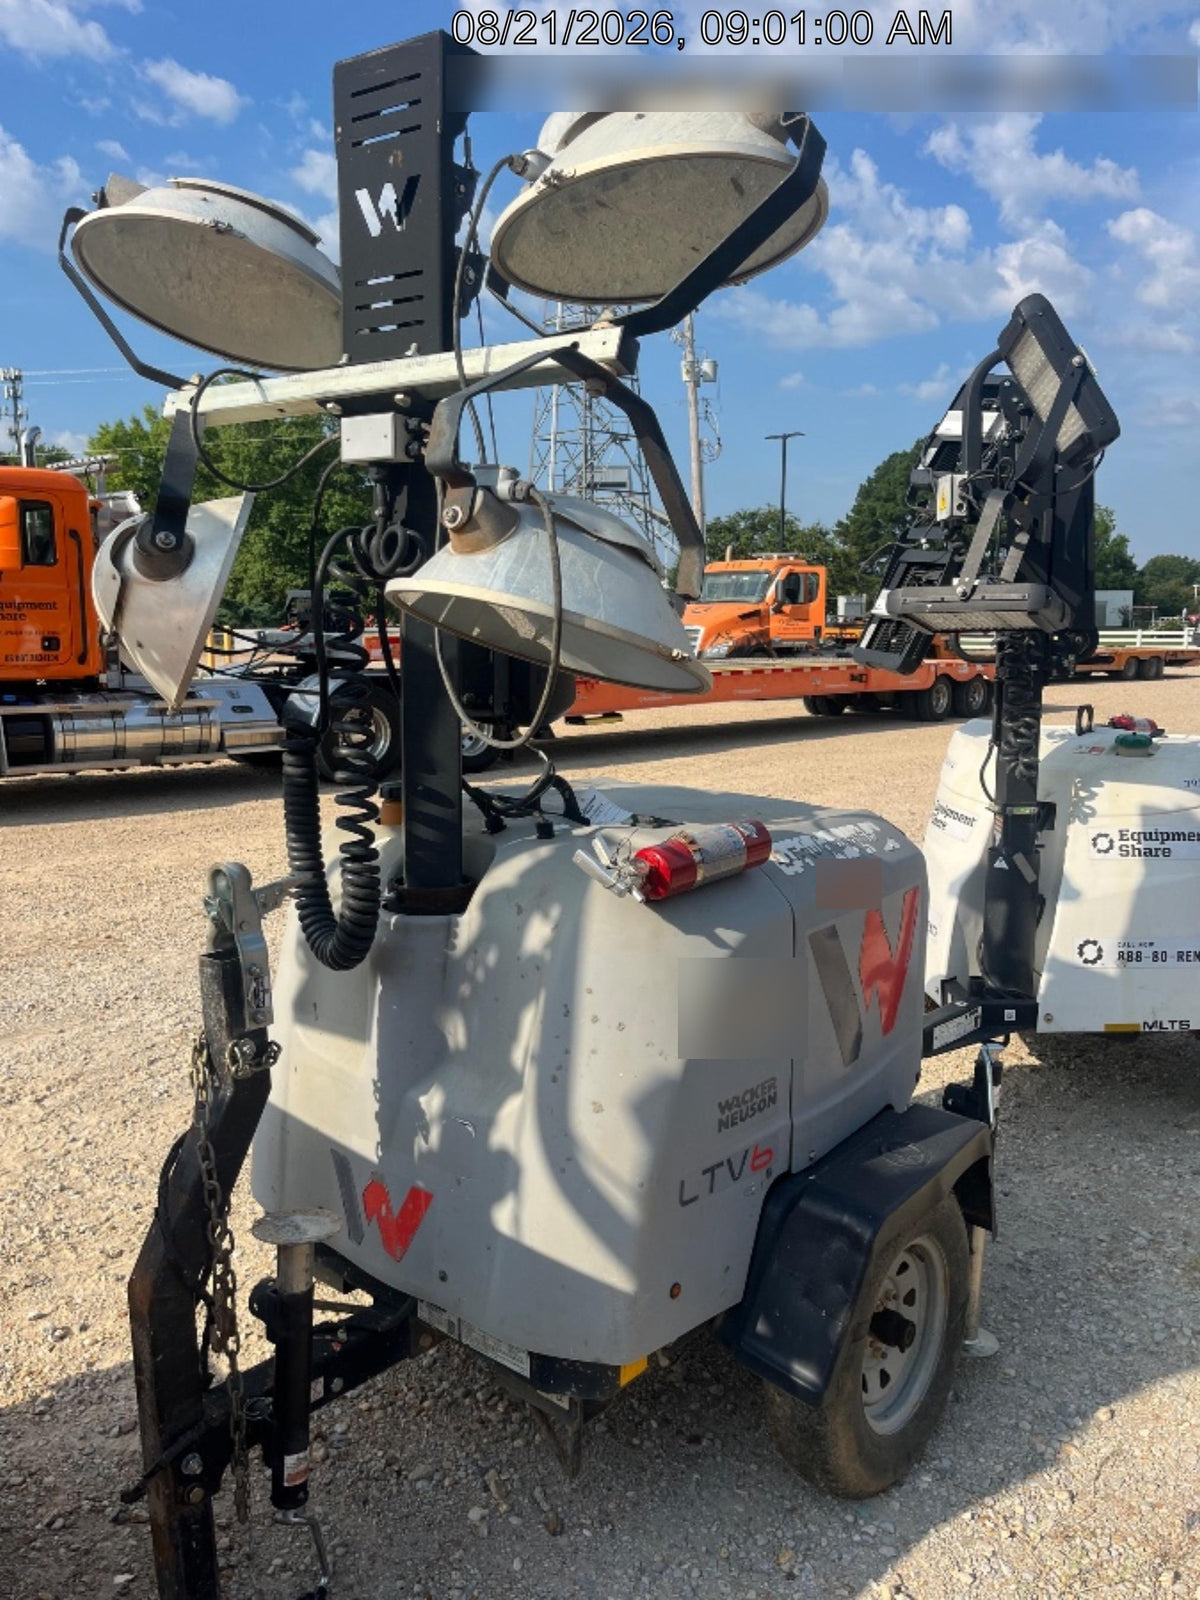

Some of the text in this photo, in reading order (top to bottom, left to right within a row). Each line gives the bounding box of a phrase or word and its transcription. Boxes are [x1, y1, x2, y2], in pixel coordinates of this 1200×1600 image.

[1118, 844, 1172, 858] Share
[717, 1091, 777, 1133] NEUSON
[718, 1077, 777, 1115] WACKER
[679, 1143, 775, 1208] LTV6
